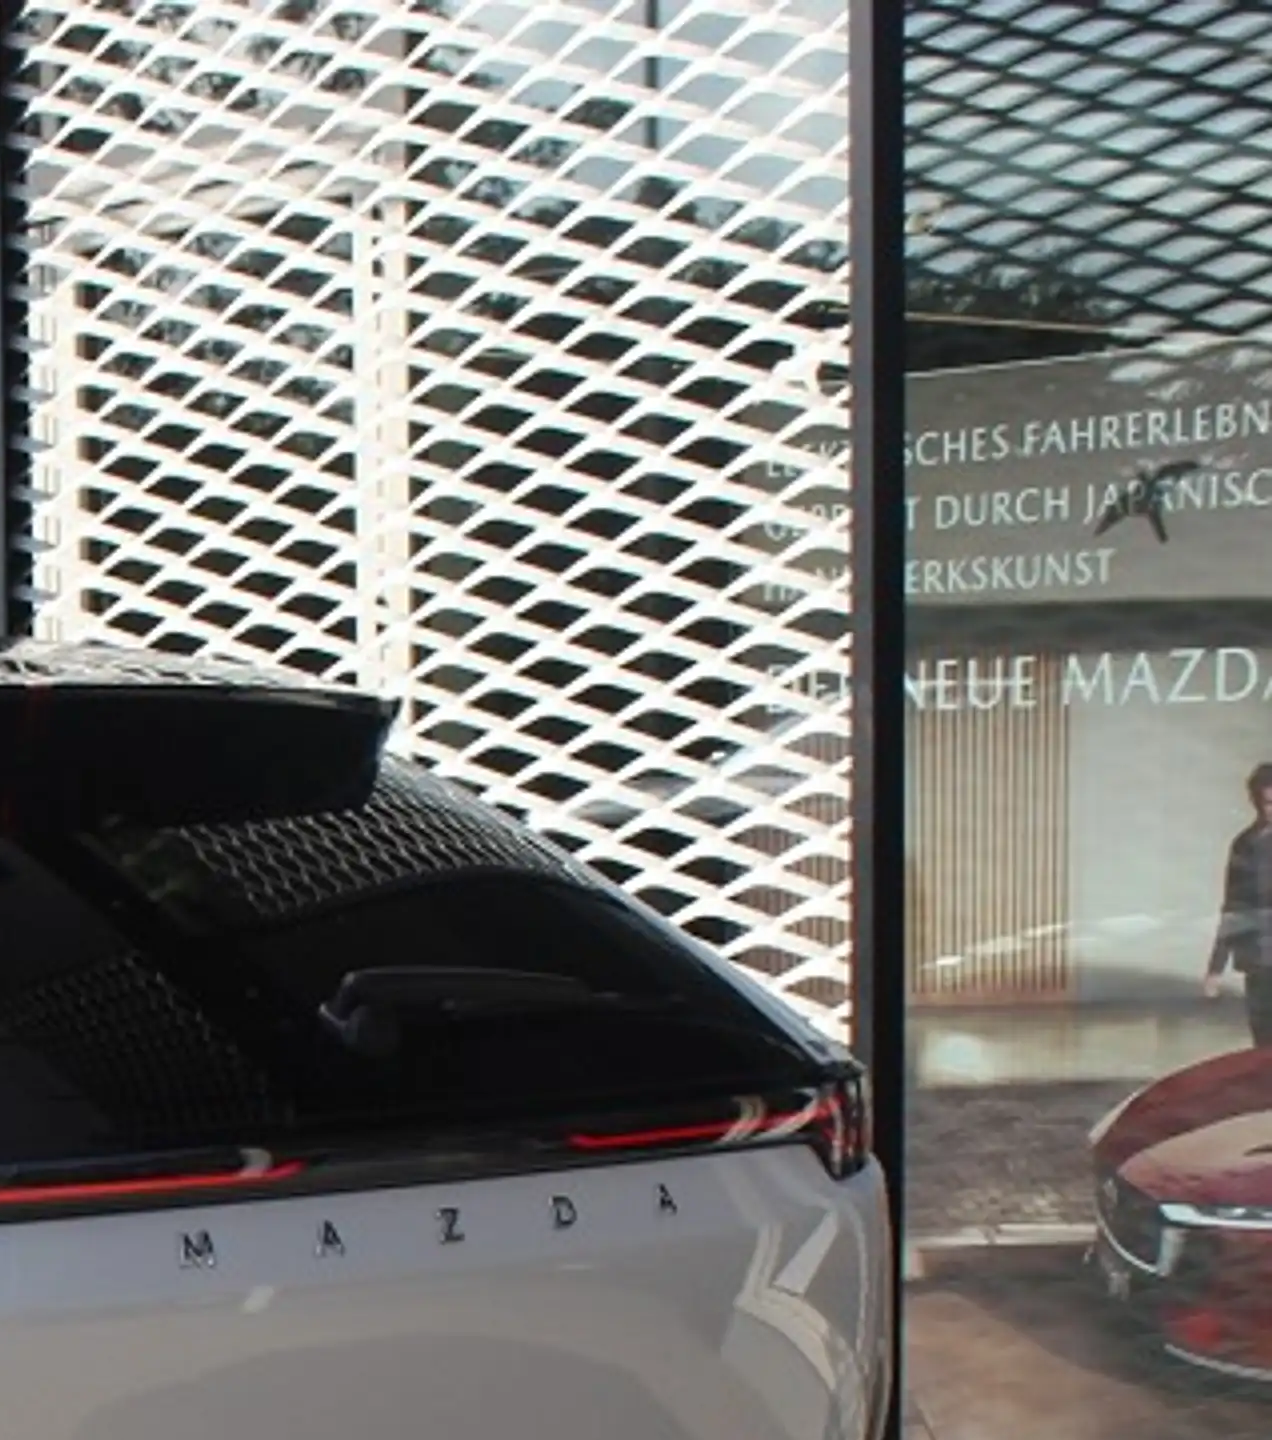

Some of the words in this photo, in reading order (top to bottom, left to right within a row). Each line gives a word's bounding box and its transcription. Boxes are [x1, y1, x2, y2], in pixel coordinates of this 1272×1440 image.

[934, 487, 1071, 530] DURCH
[1061, 647, 1272, 706] MAZD
[180, 1183, 679, 1268] MAZDA
